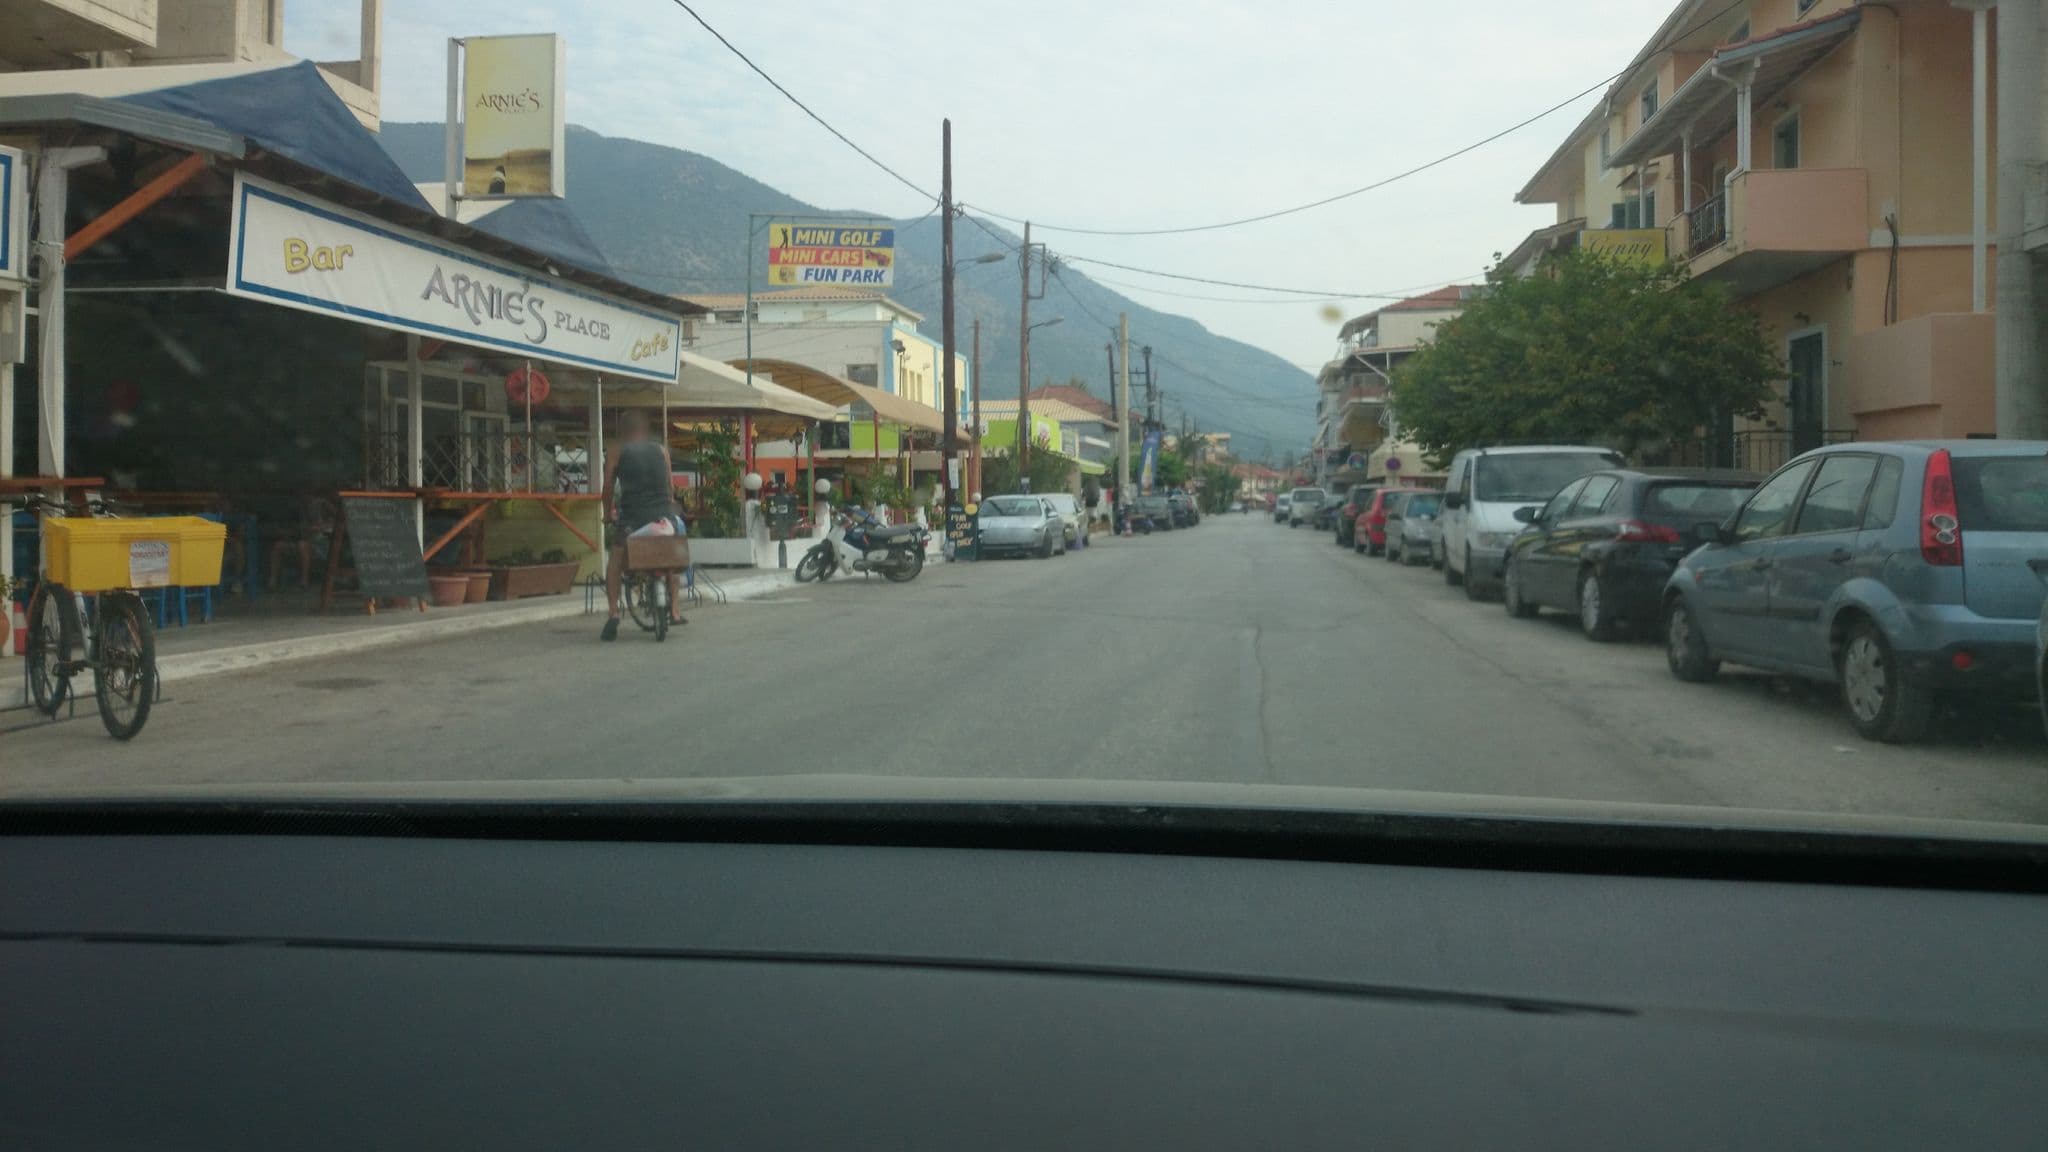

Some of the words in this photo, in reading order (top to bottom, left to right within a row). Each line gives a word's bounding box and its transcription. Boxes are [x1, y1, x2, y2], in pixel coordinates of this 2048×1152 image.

[476, 88, 541, 113] ARNIE'S
[795, 229, 835, 247] MINI
[840, 231, 881, 247] GOLF
[283, 237, 354, 274] Bar
[779, 249, 817, 264] MINI
[820, 250, 861, 265] CARS
[803, 268, 838, 282] FUN
[841, 269, 885, 283] PARK
[421, 264, 547, 343] ARNIE'S
[553, 310, 611, 341] PLACE
